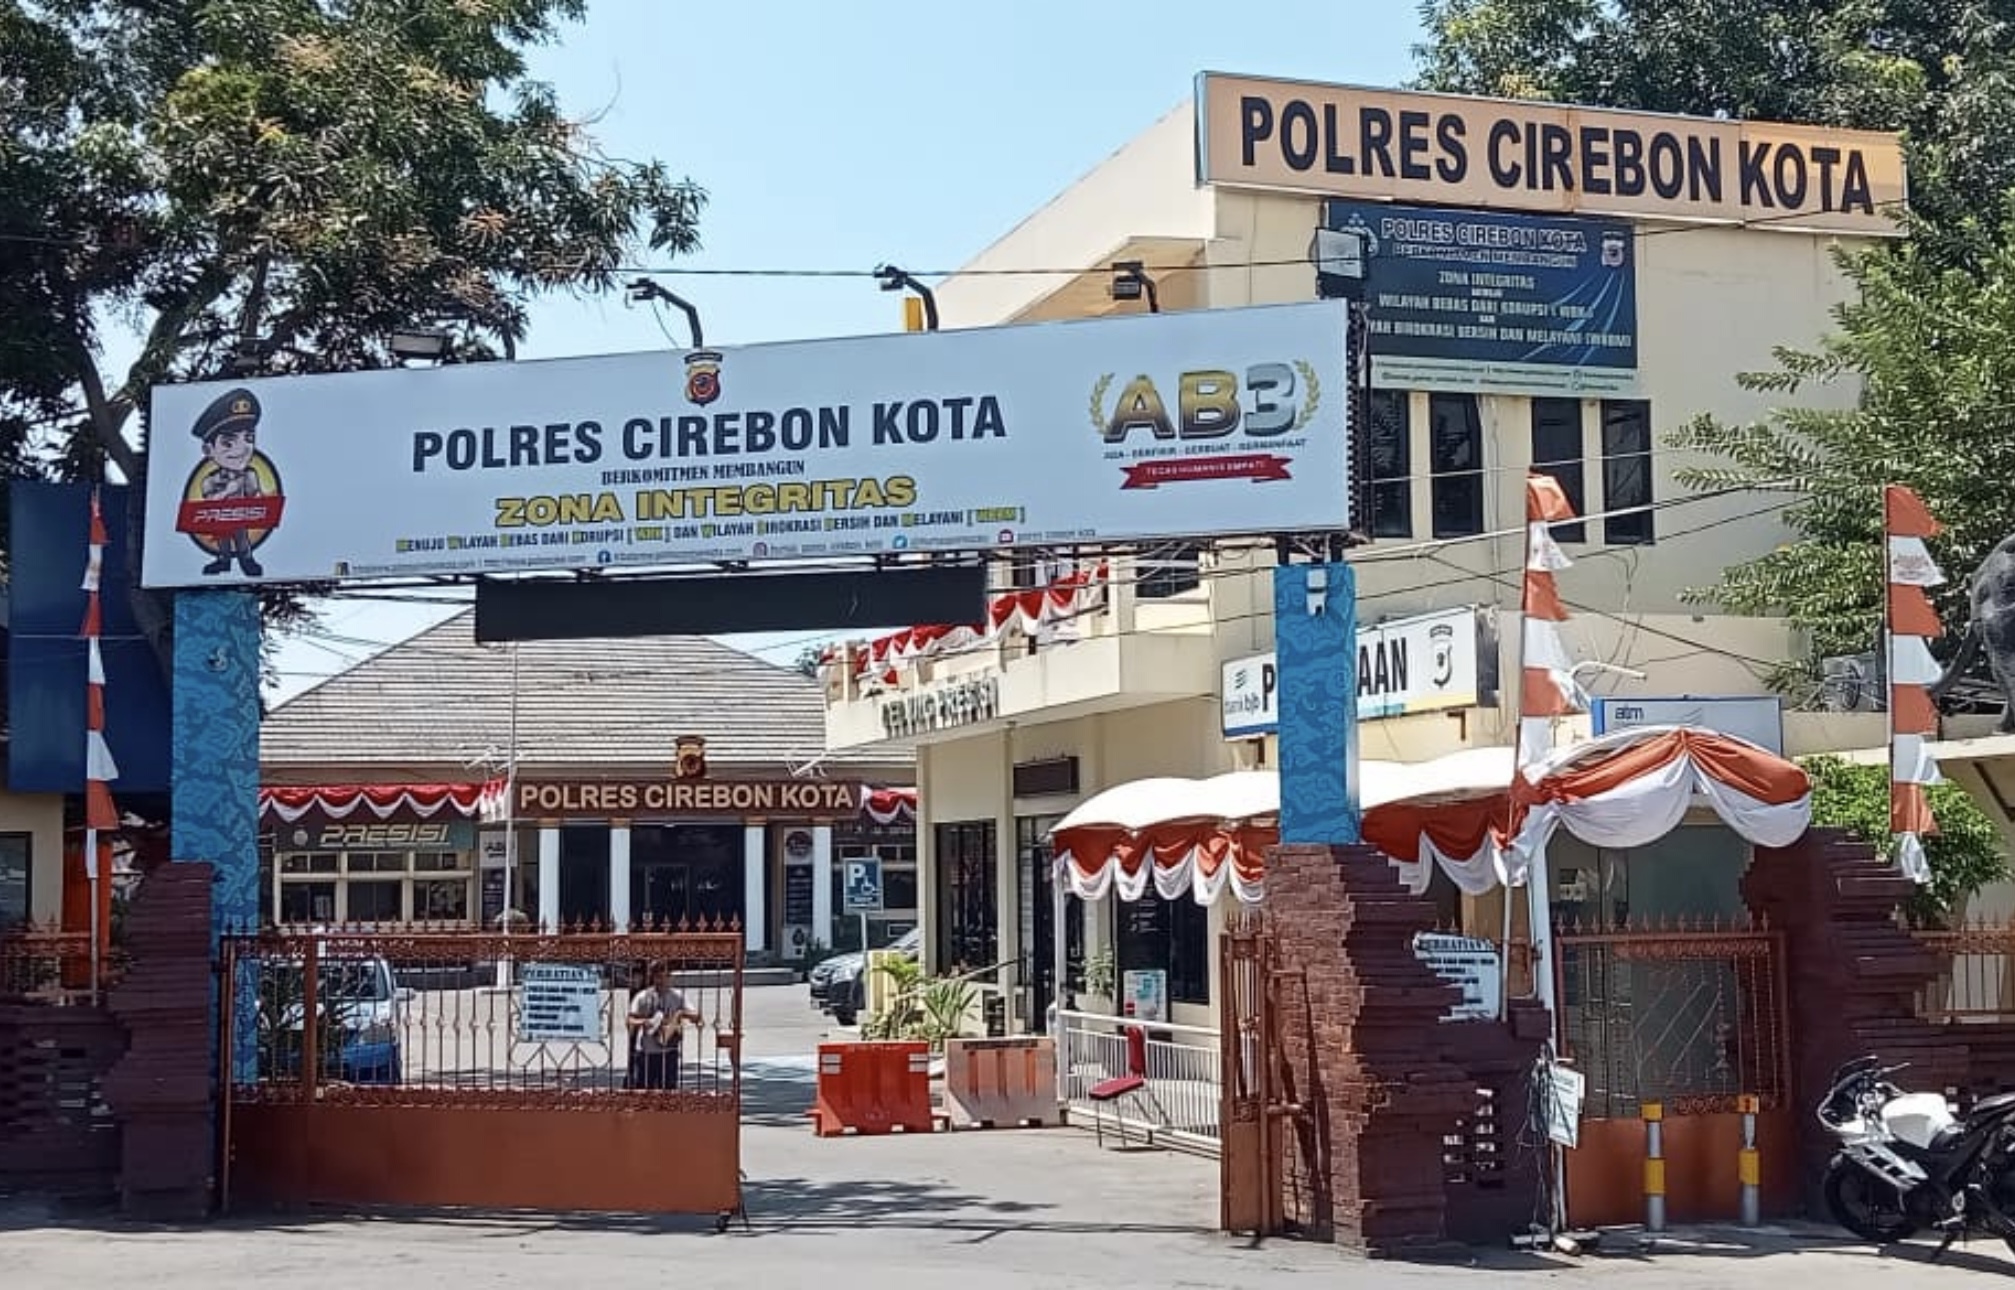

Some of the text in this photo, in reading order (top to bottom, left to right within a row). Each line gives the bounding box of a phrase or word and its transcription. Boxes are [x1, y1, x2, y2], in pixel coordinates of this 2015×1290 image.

[1241, 96, 1875, 215] POLRES CIREBON KOTA
[1381, 218, 1587, 252] POLRES CIREBON KOTA
[1103, 363, 1296, 443] AB3
[413, 396, 1006, 472] POLRES CIREBON KOTA
[602, 459, 804, 485] BERKOMITMEN MEMBANGUN
[495, 475, 917, 528] ZONA INTEGRITAS
[541, 531, 569, 547] DARI
[673, 523, 698, 538] DAN
[874, 513, 898, 528] DAN
[1614, 706, 1644, 720] atm
[520, 784, 853, 809] POLRES CIREBON KOTA
[319, 824, 450, 846] PRESISI
[849, 863, 866, 887] P
